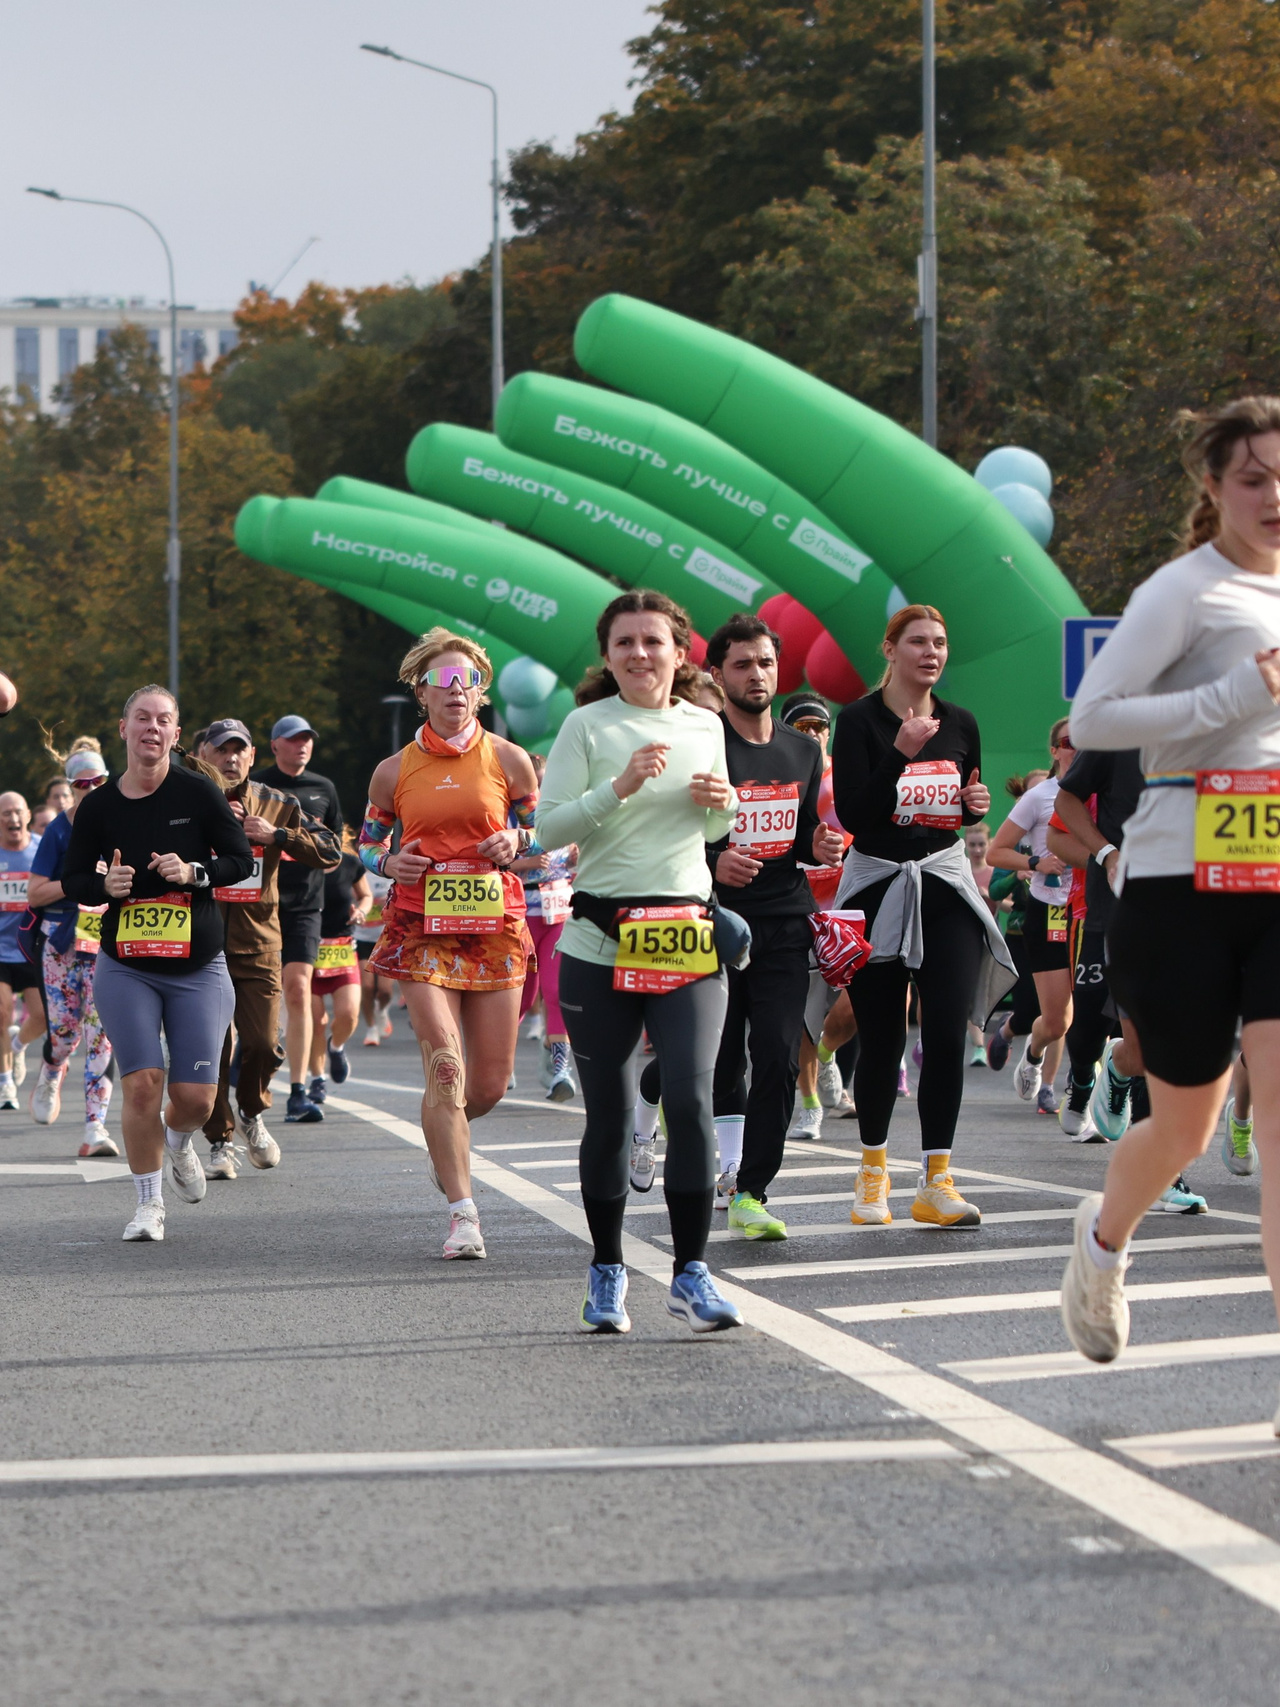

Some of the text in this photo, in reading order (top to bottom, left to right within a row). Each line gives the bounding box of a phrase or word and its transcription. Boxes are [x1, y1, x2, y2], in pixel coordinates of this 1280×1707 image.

[554, 414, 857, 571] Бежать лучше с Прайм
[463, 457, 749, 595] Бежать лучше с Прайм
[311, 530, 458, 581] Настройся
[463, 574, 478, 589] с
[901, 784, 960, 806] 28952
[734, 809, 795, 833] 31330
[901, 815, 910, 825] D
[1208, 865, 1223, 889] E
[428, 879, 500, 902] 25356
[123, 907, 188, 929] 15379
[432, 918, 441, 932] E
[626, 926, 714, 955] 15300
[1052, 931, 1059, 940] E
[124, 943, 132, 955] E
[315, 948, 348, 961] 5990
[651, 956, 685, 966] ИРИНА
[624, 971, 636, 988] E
[1076, 963, 1104, 985] 23
